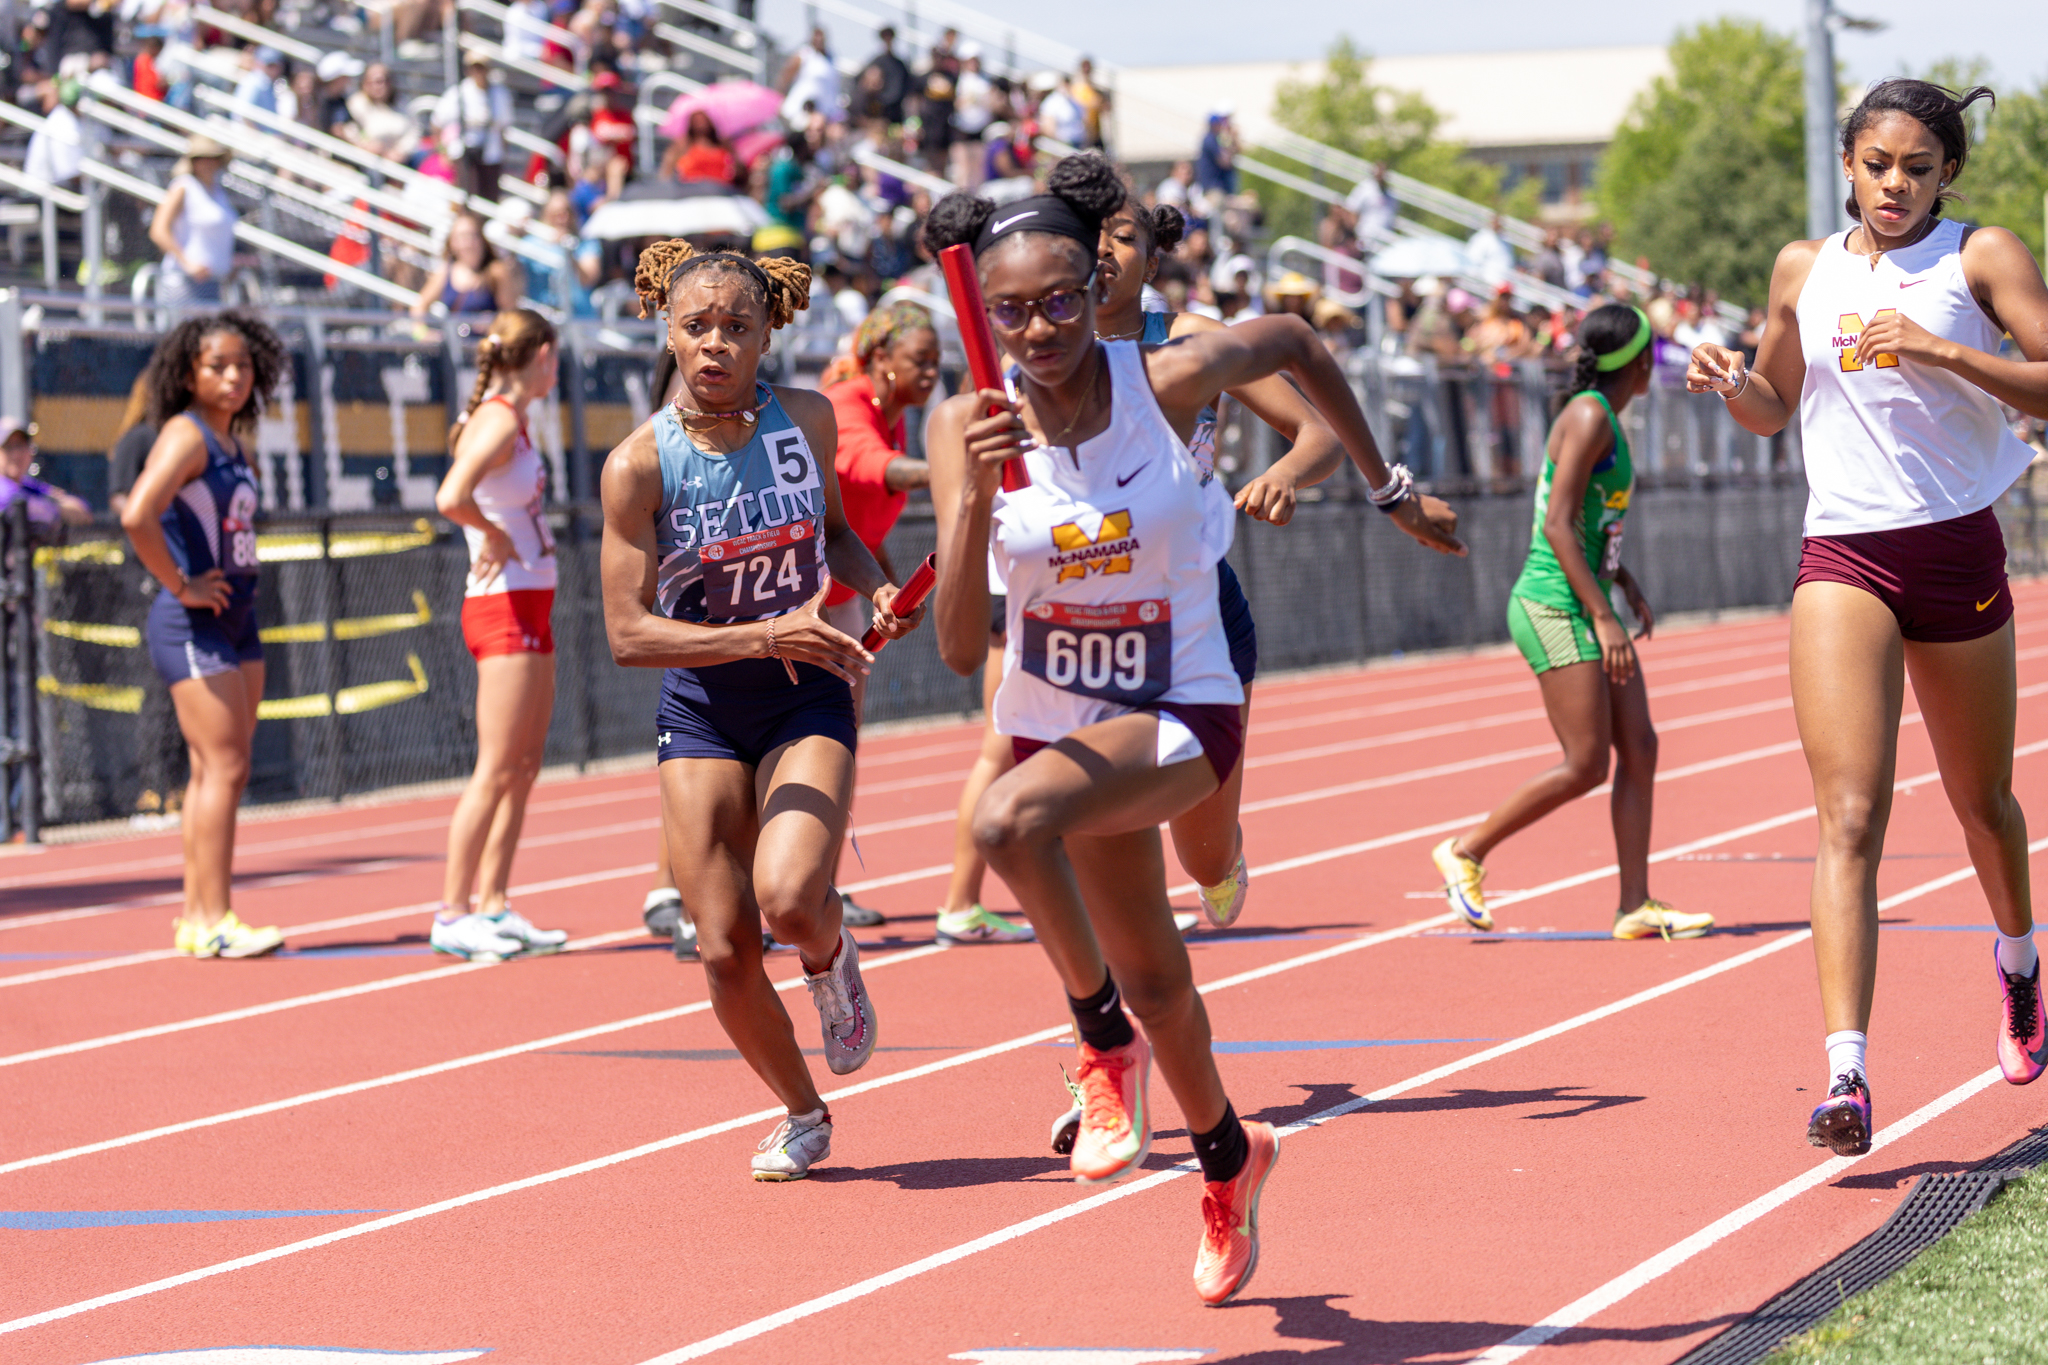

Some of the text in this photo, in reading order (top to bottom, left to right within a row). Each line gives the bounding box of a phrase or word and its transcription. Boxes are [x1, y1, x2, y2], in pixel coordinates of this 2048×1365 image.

[775, 436, 809, 484] 5
[669, 484, 816, 549] SETON
[747, 534, 762, 543] TRACK
[766, 529, 781, 539] FIELD
[738, 540, 778, 555] CHAMPIONSHIPS
[1048, 537, 1140, 568] McNAMARA
[722, 548, 803, 606] 724
[1045, 629, 1148, 691] 609
